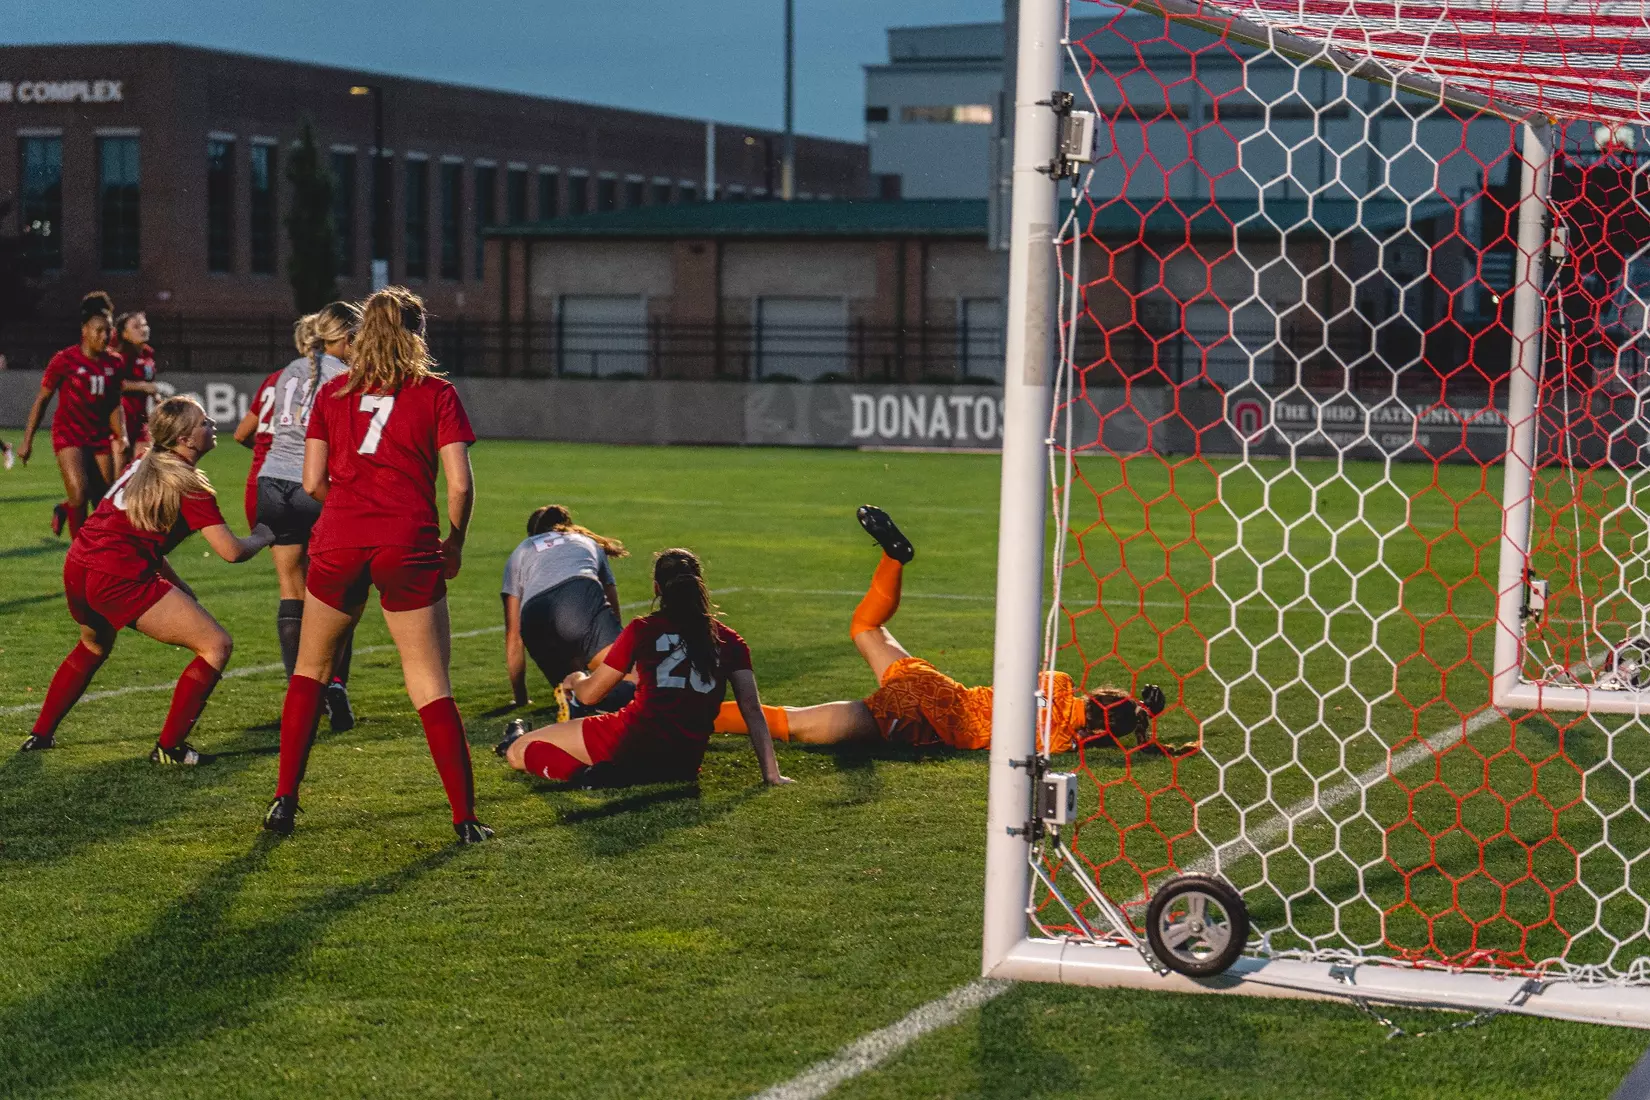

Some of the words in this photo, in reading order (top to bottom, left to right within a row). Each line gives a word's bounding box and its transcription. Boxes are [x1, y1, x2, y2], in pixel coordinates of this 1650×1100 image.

[17, 80, 122, 103] COMPLEX
[90, 375, 105, 395] 11
[851, 394, 1004, 440] DONATO
[1276, 402, 1308, 420] THE
[357, 395, 395, 454] 7
